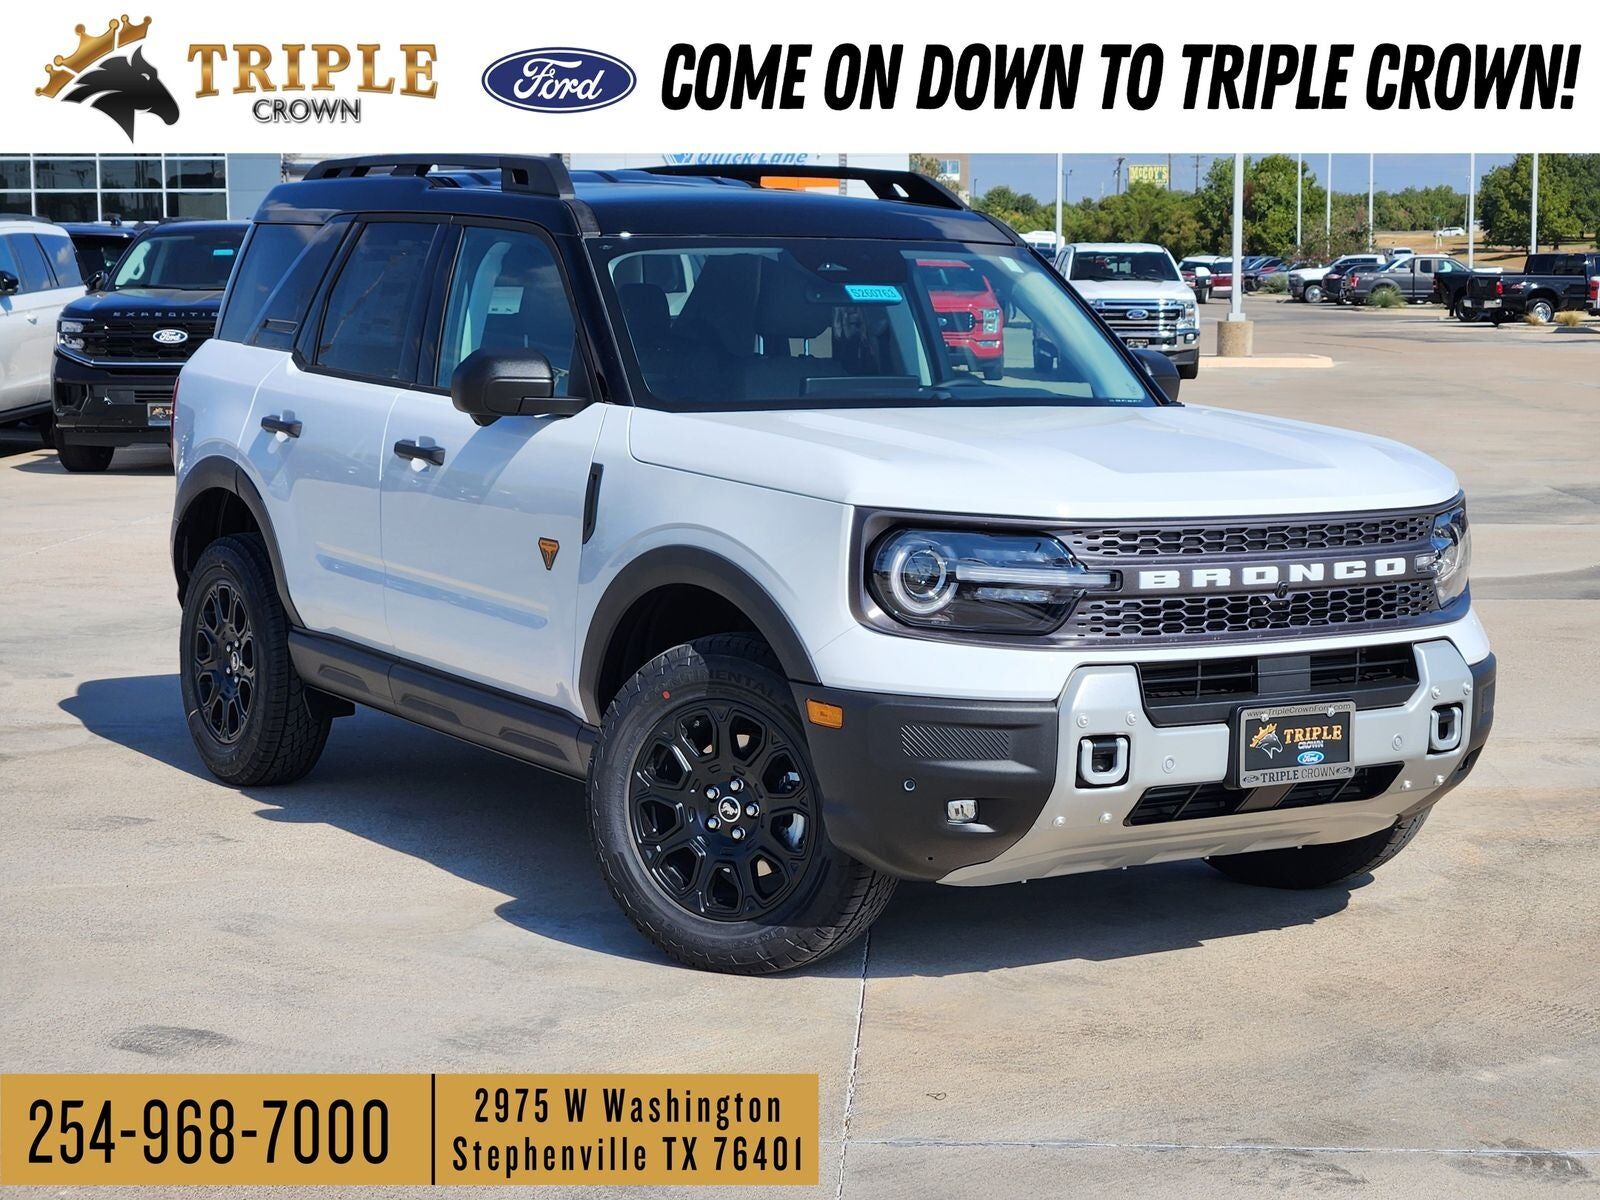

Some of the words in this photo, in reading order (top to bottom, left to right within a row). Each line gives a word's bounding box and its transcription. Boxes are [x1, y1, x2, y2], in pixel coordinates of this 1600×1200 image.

[758, 153, 808, 165] Lane
[1138, 557, 1406, 590] BRONCO
[1284, 725, 1342, 744] TRIPLE
[1298, 740, 1324, 749] CROWN
[1261, 769, 1299, 783] TRIPLE
[1301, 766, 1335, 779] CROWN
